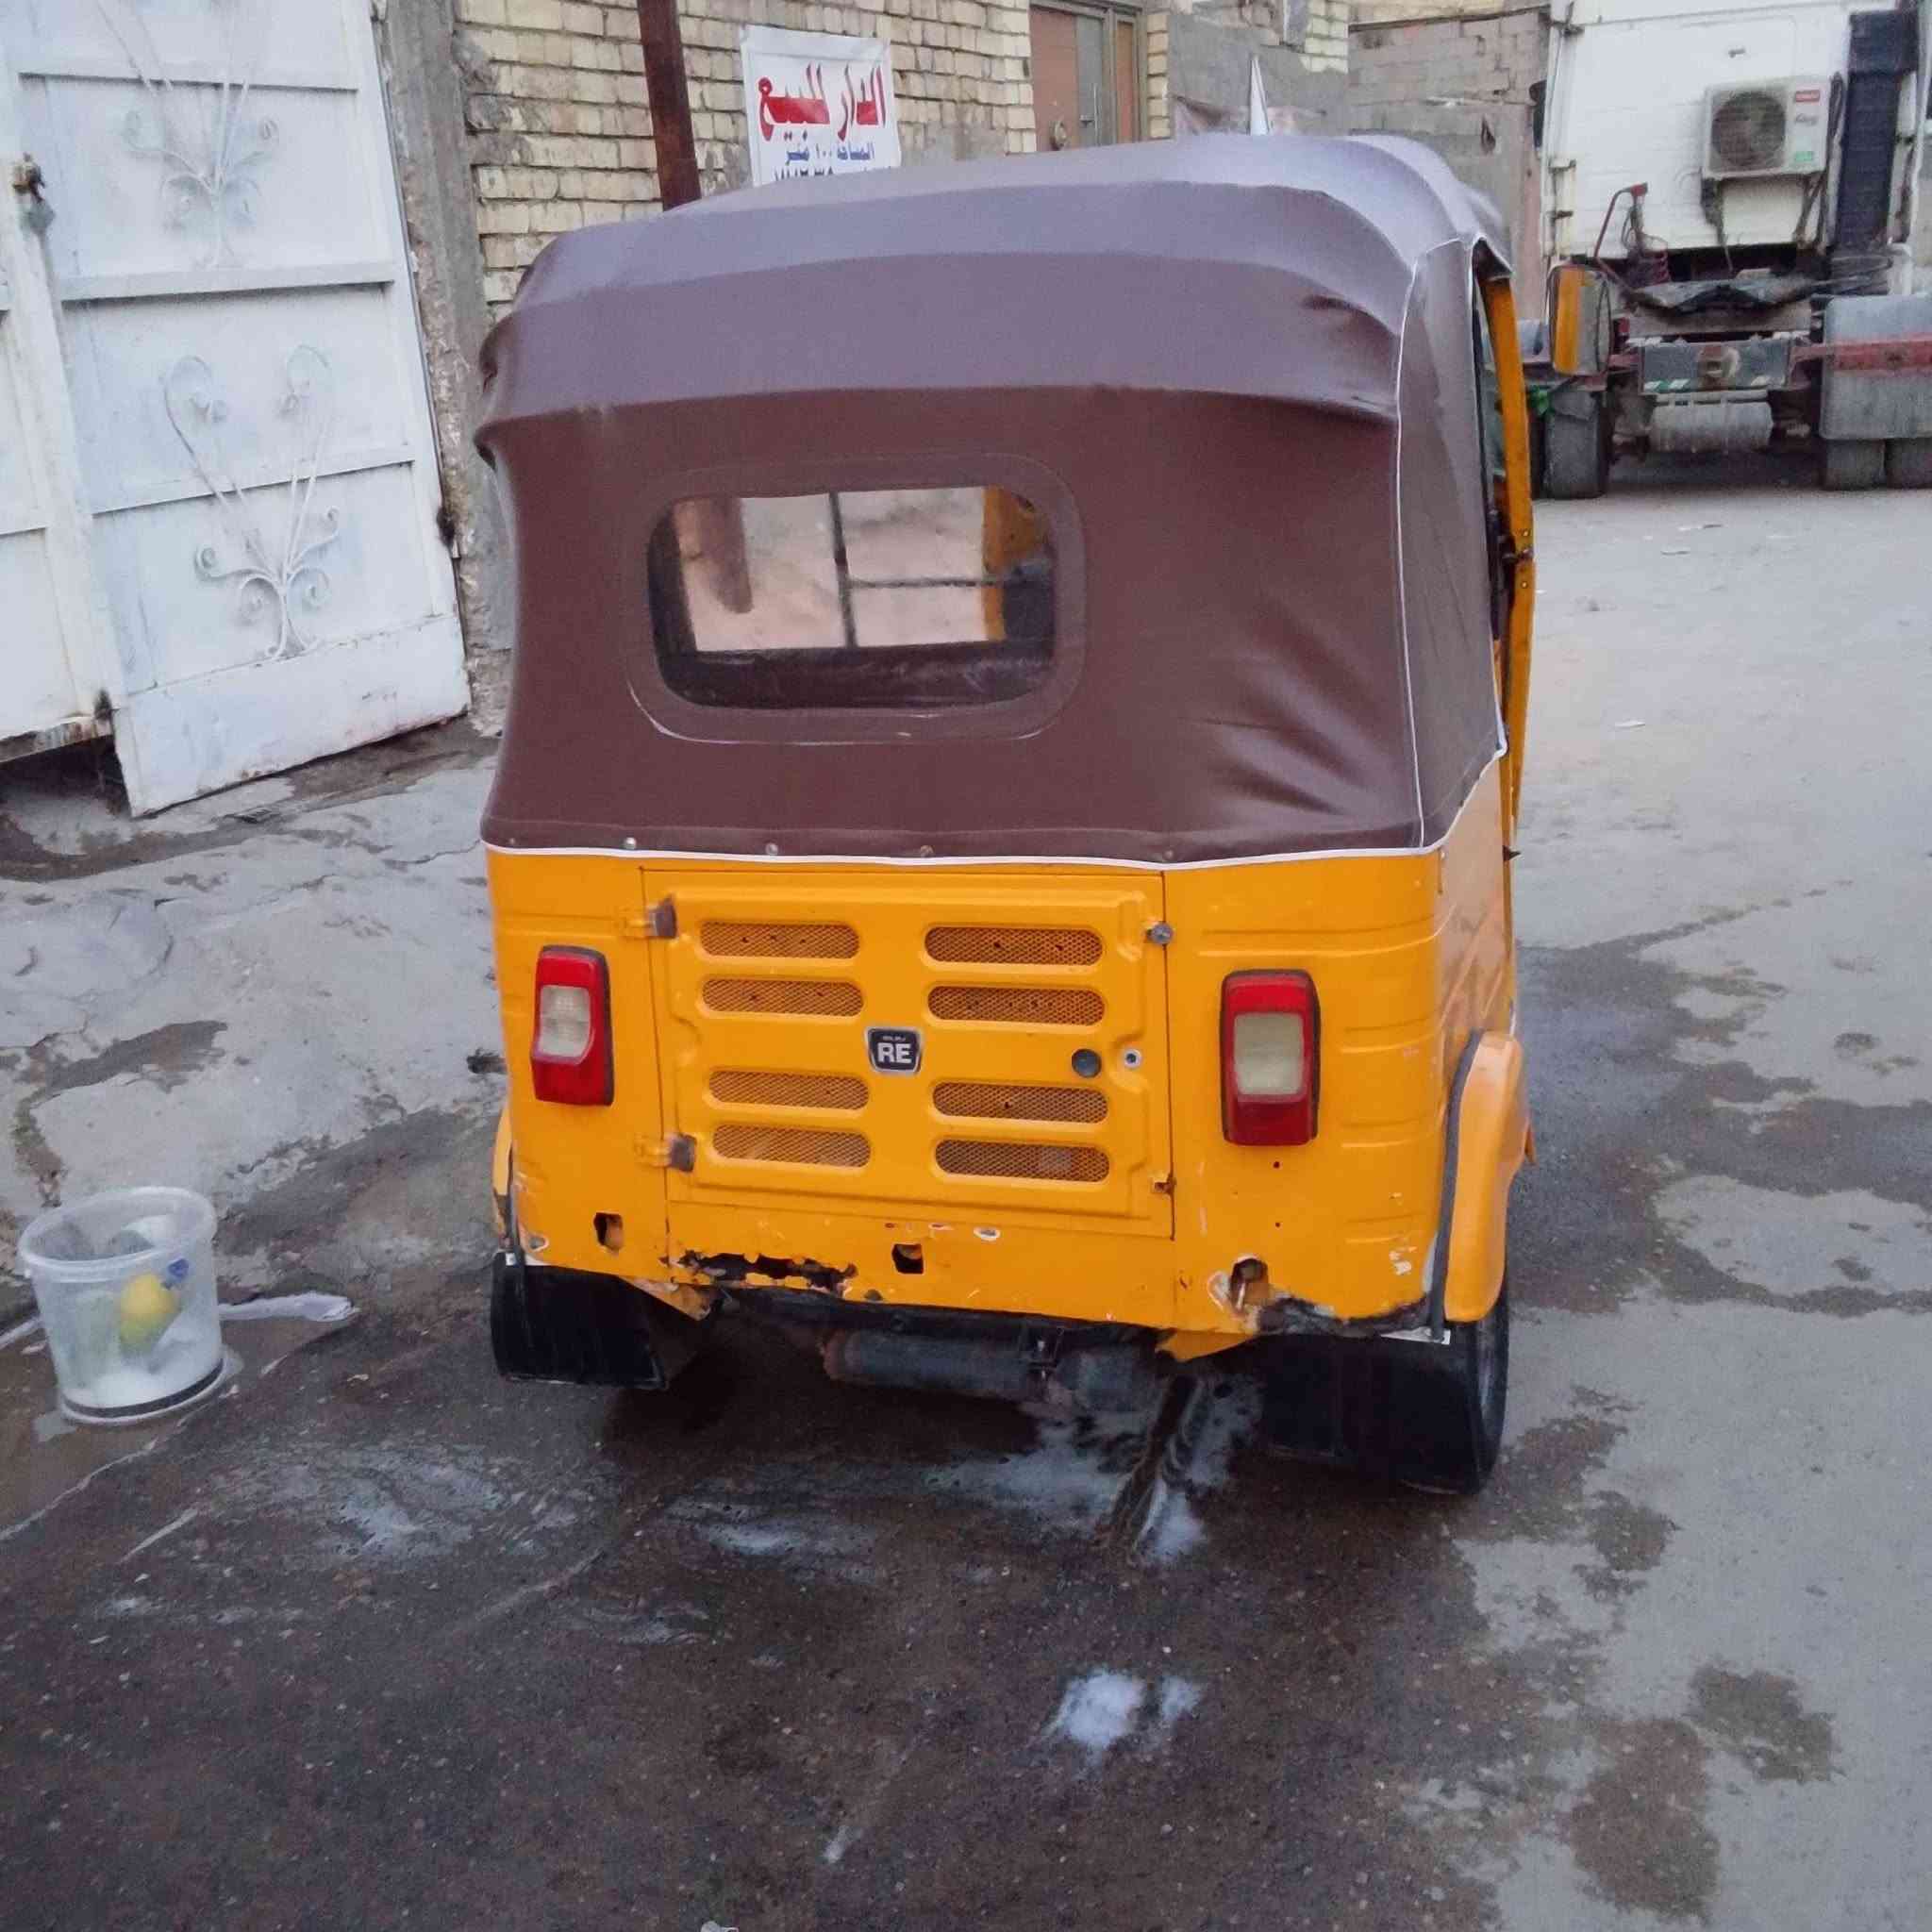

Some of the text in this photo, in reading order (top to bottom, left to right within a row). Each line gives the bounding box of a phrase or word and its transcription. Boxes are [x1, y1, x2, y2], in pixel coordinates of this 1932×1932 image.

[758, 60, 887, 142] الدار للبيع
[877, 1041, 912, 1064] RE
